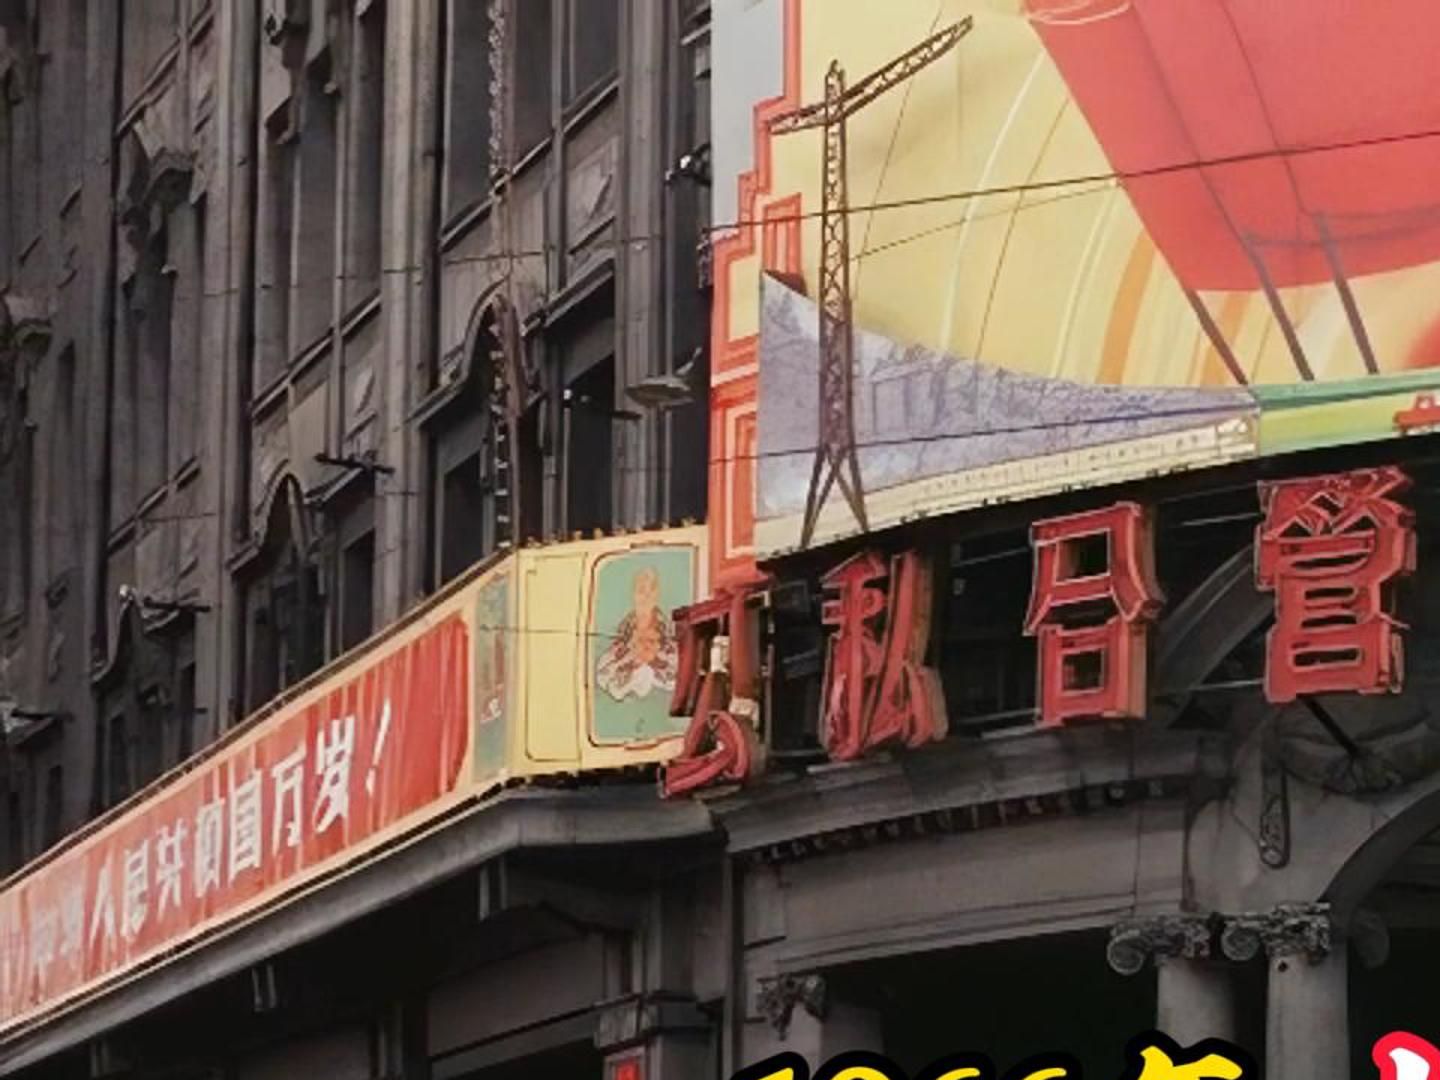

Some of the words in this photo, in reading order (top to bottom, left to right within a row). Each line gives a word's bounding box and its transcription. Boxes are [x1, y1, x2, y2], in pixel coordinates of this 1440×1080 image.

[30, 697, 391, 963] 人民共和国万岁！
